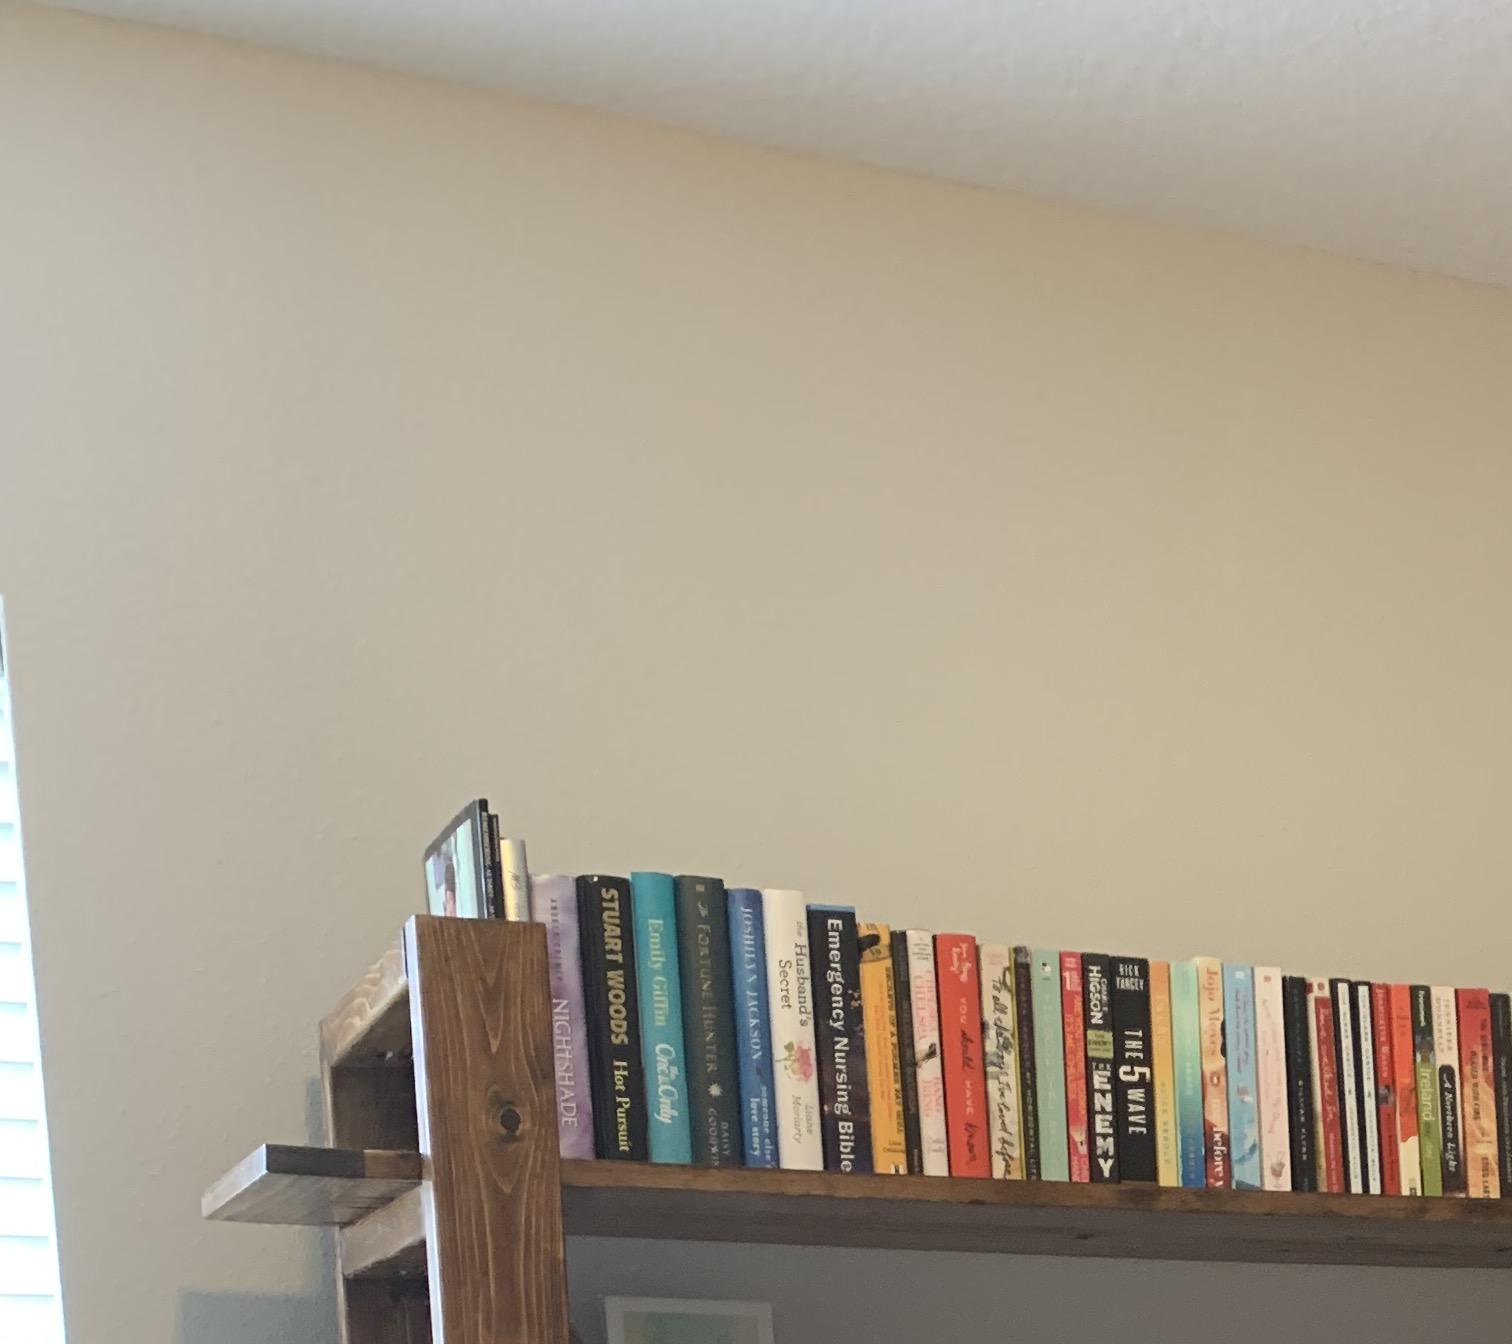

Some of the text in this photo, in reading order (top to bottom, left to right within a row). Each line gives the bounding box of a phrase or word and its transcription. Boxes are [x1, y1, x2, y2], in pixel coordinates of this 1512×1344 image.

[601, 887, 628, 1045] STUART WOODS
[647, 919, 669, 1026] Emily Giffin
[740, 906, 763, 1060] JOSHILYN JACKSON
[778, 959, 793, 1009] Secret
[794, 920, 810, 1027] the Husband's
[992, 976, 1003, 994] To
[1115, 977, 1145, 993] YANCEY
[1119, 964, 1140, 978] RICK
[959, 997, 968, 1025] YOU
[992, 995, 1009, 1016] all
[1088, 965, 1104, 1025] HIGSON
[1203, 968, 1221, 1057] Jojo Moyes
[552, 998, 577, 1127] NIGHTSHADE
[826, 919, 855, 1171] Emergency Nursing Bible
[612, 1060, 632, 1152] Hot Pursuit
[653, 1085, 678, 1124] Only
[1119, 1029, 1150, 1135] THE 5 WAVE
[1420, 1067, 1436, 1121] Ireland
[720, 1121, 731, 1156] DAISY
[749, 1097, 763, 1157] love story
[791, 1095, 806, 1144] Moriarty
[803, 1103, 815, 1135] Liane
[997, 1102, 1013, 1136] loved
[1093, 1070, 1115, 1178] ENEMY
[1444, 1091, 1455, 1139] Northern
[1213, 1126, 1228, 1177] before
[1445, 1141, 1458, 1172] Light
